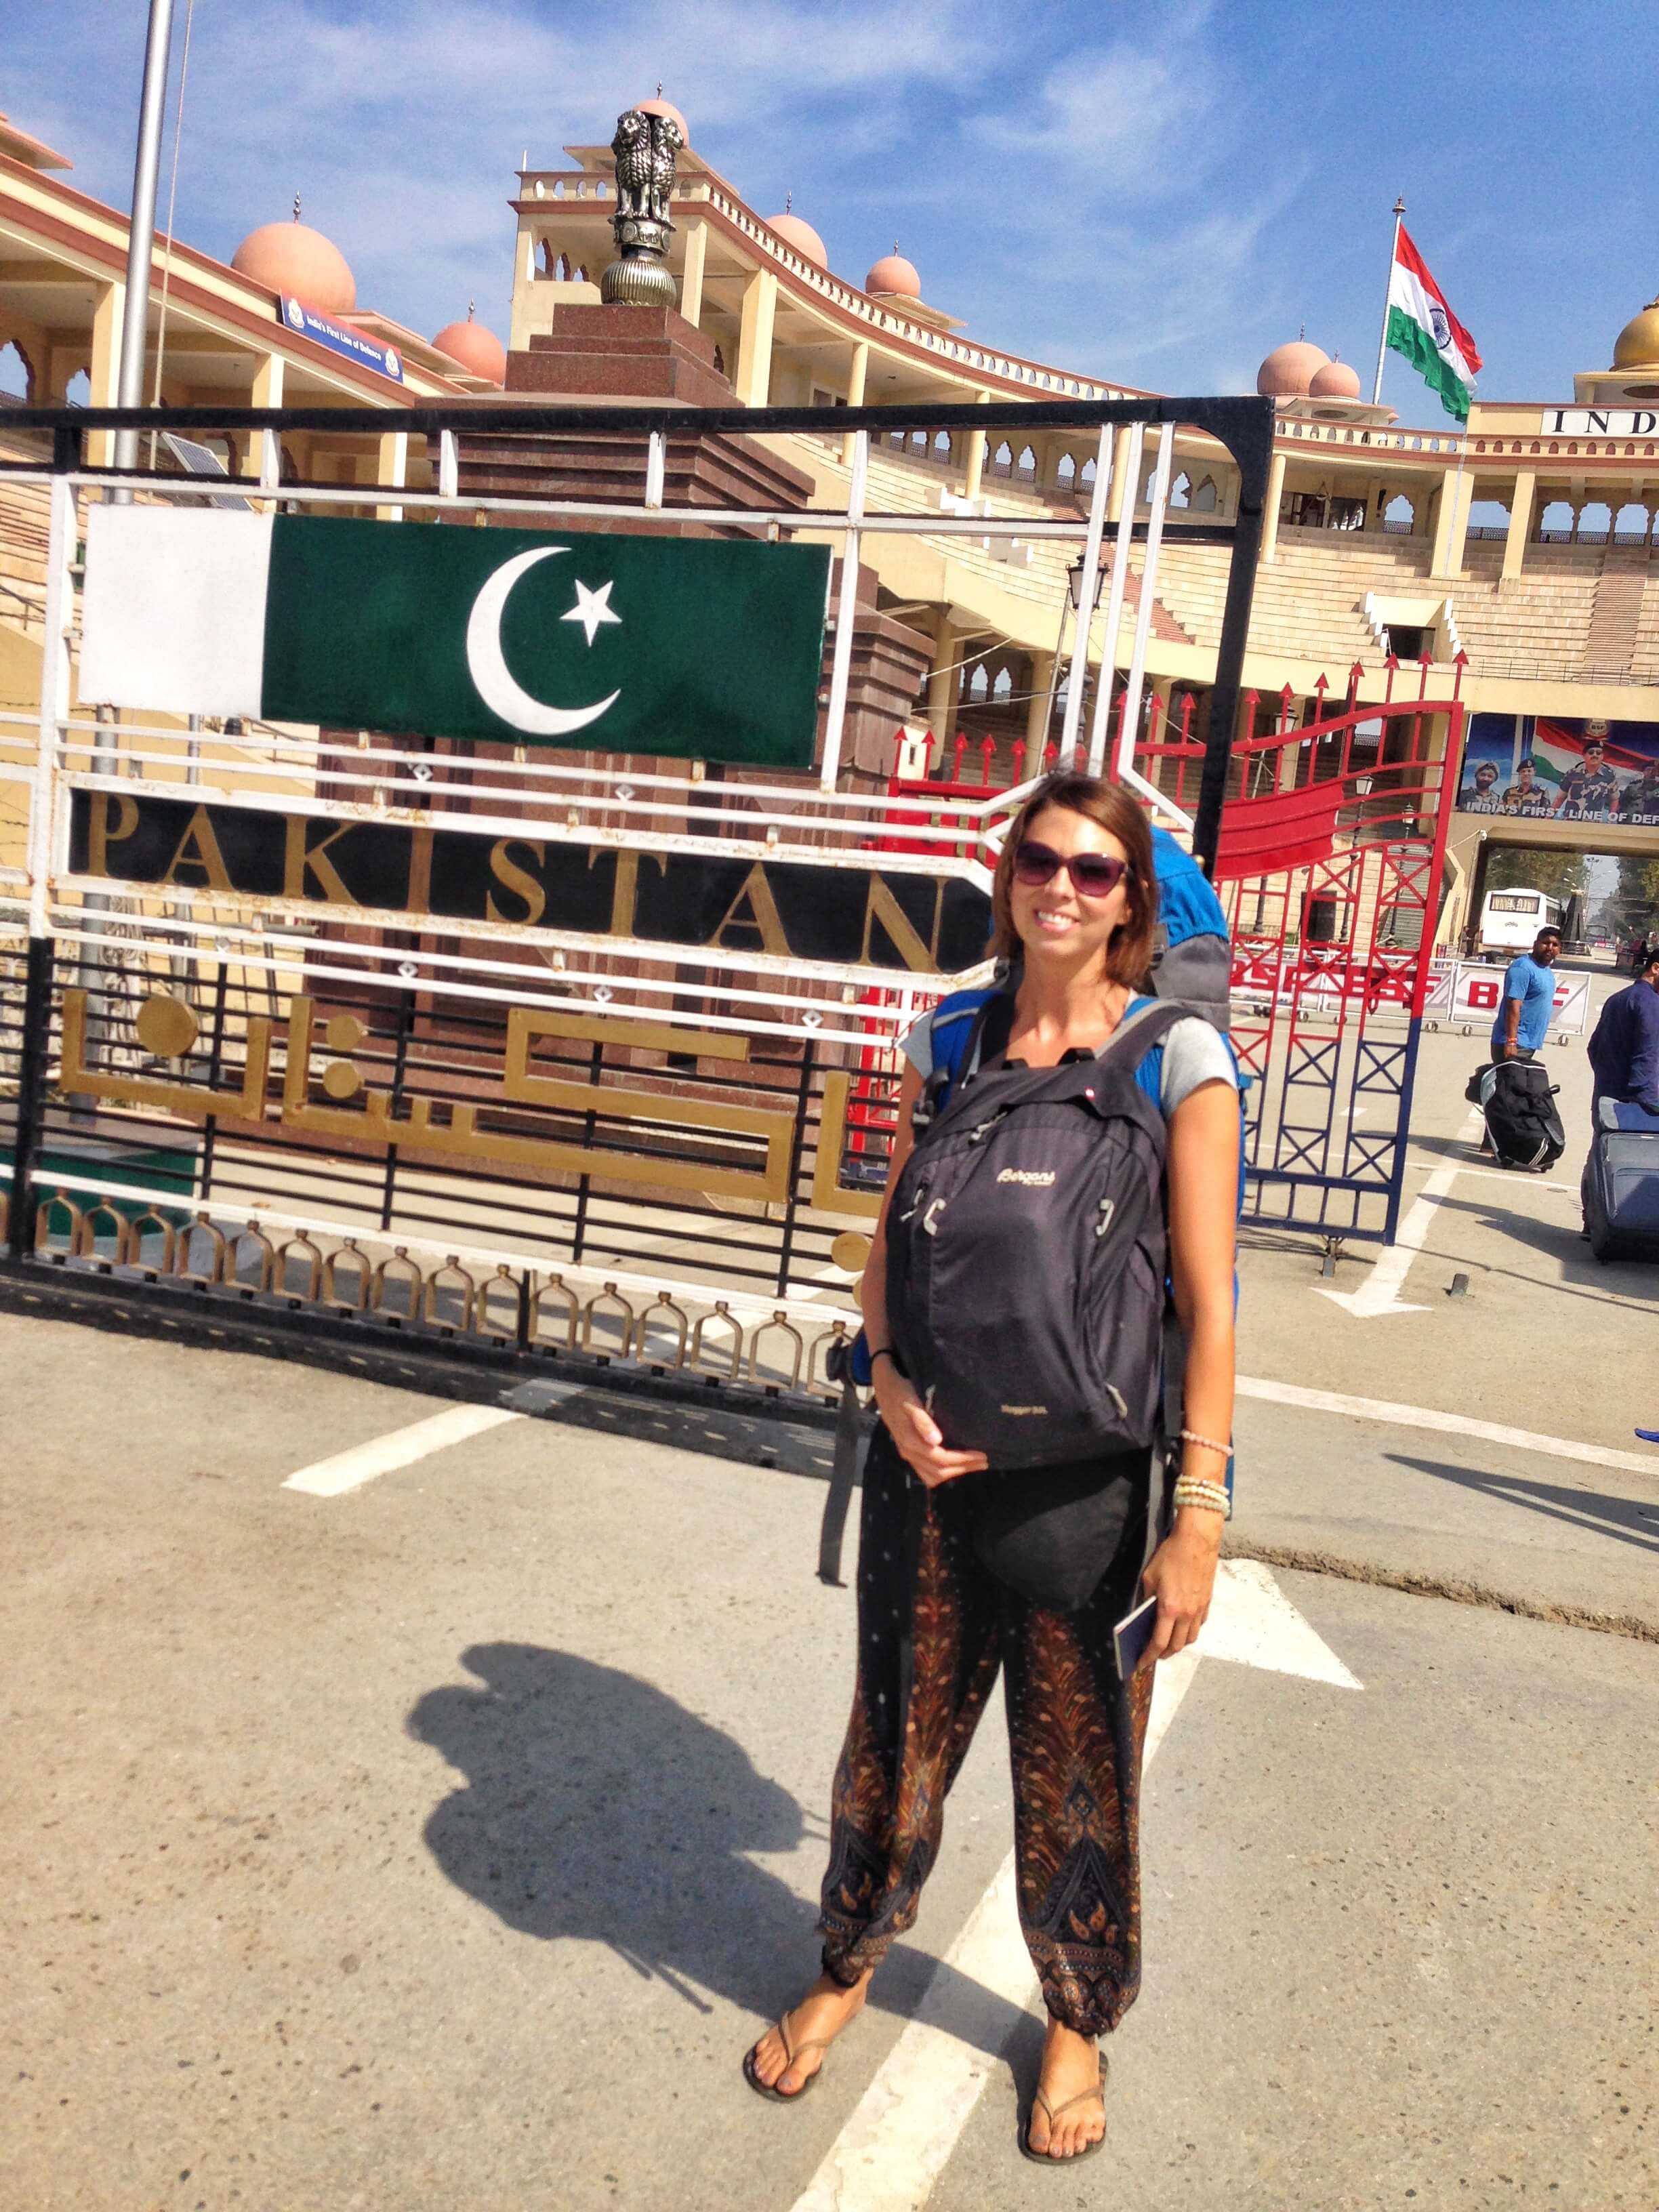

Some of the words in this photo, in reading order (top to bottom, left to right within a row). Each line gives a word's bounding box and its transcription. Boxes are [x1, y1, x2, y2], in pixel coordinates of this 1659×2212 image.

[326, 325, 340, 340] First
[340, 331, 352, 346] Line
[352, 340, 359, 350] of
[1466, 801, 1518, 814] INDIA'S
[1522, 805, 1563, 817] FIRST
[1569, 809, 1603, 821] LINE
[1607, 812, 1628, 822] OF
[85, 787, 950, 976] PAKISTAN
